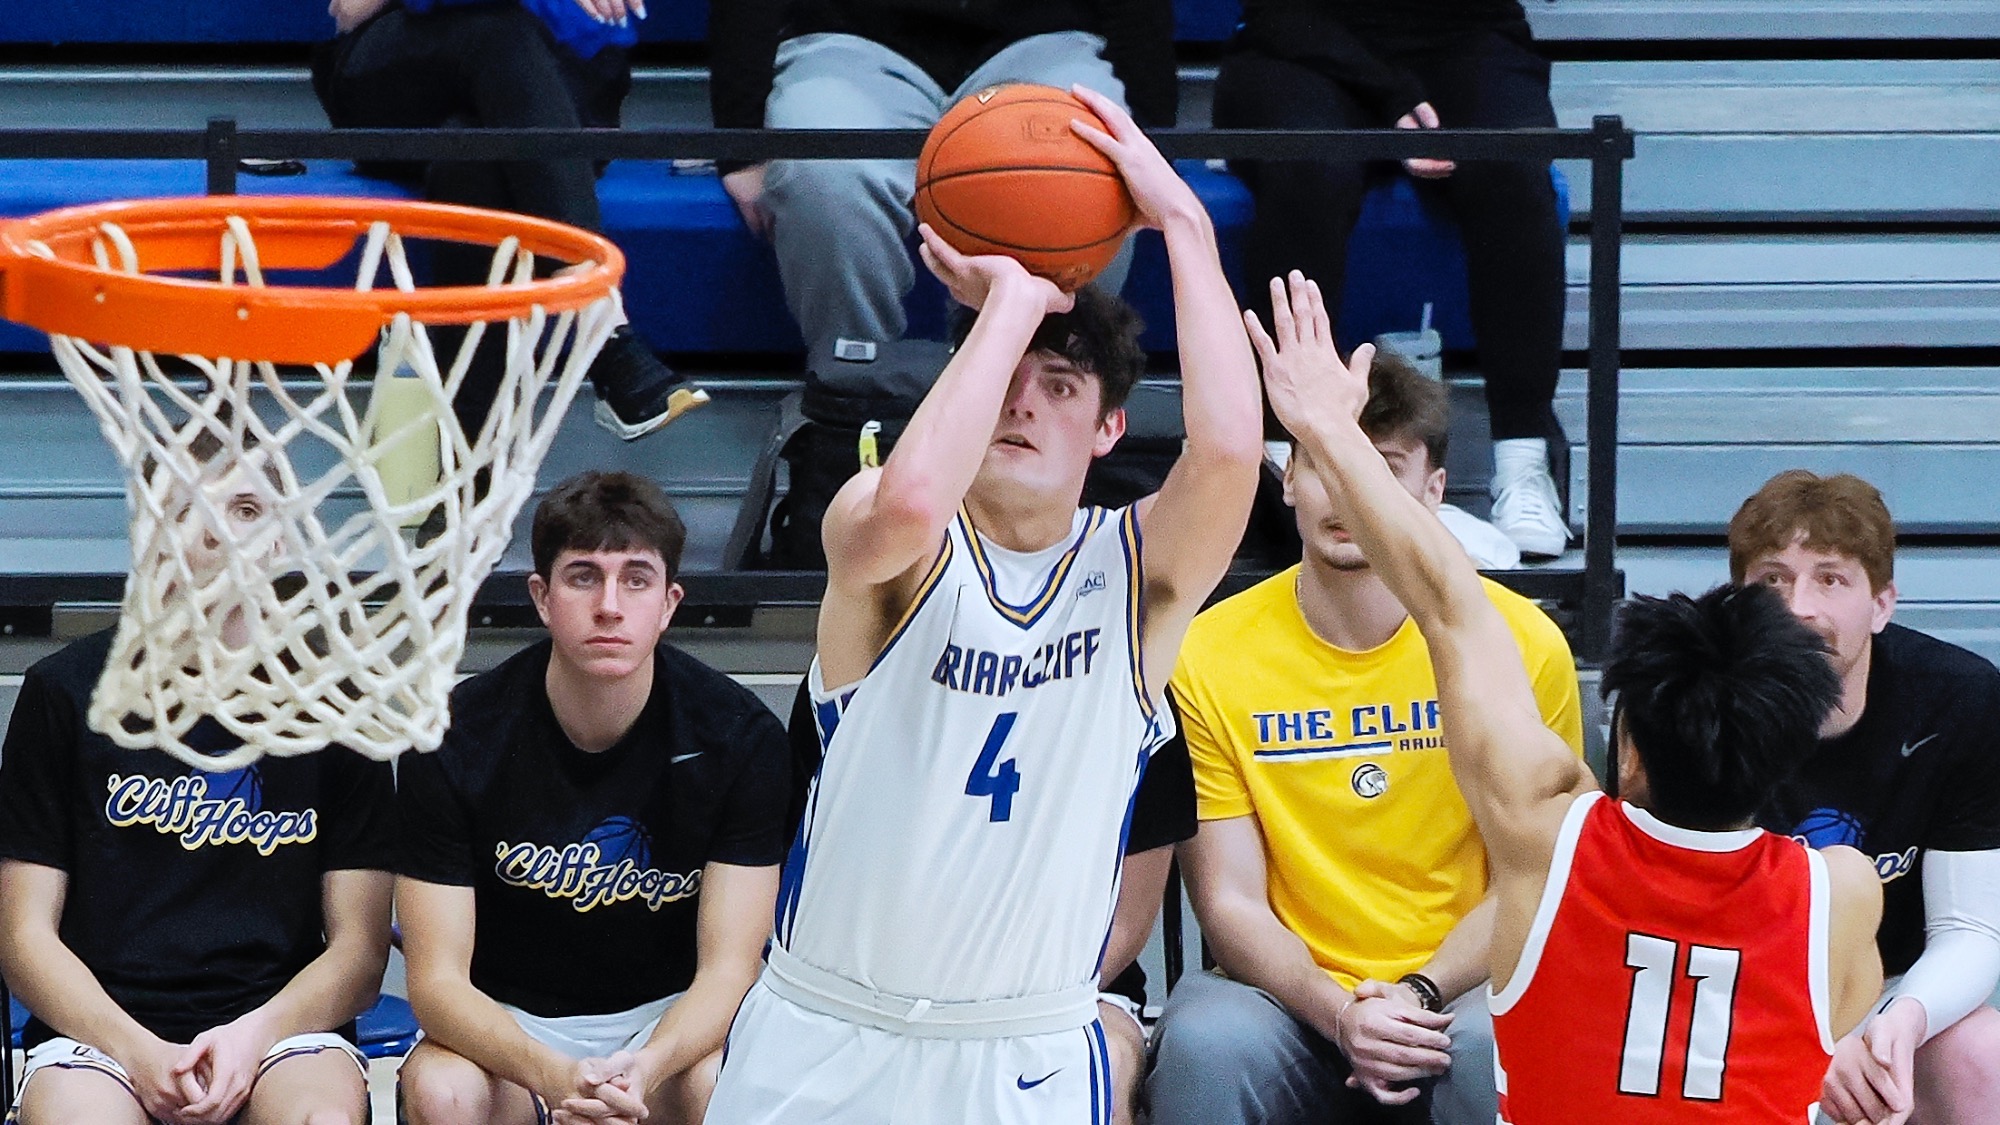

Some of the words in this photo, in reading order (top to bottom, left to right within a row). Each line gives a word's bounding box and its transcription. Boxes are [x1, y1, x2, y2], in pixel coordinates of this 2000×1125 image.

[1253, 710, 1334, 743] THE
[964, 711, 1021, 823] 4
[180, 798, 318, 856] Hoops
[572, 857, 702, 912] Hoops
[1618, 930, 1741, 1101] 11
